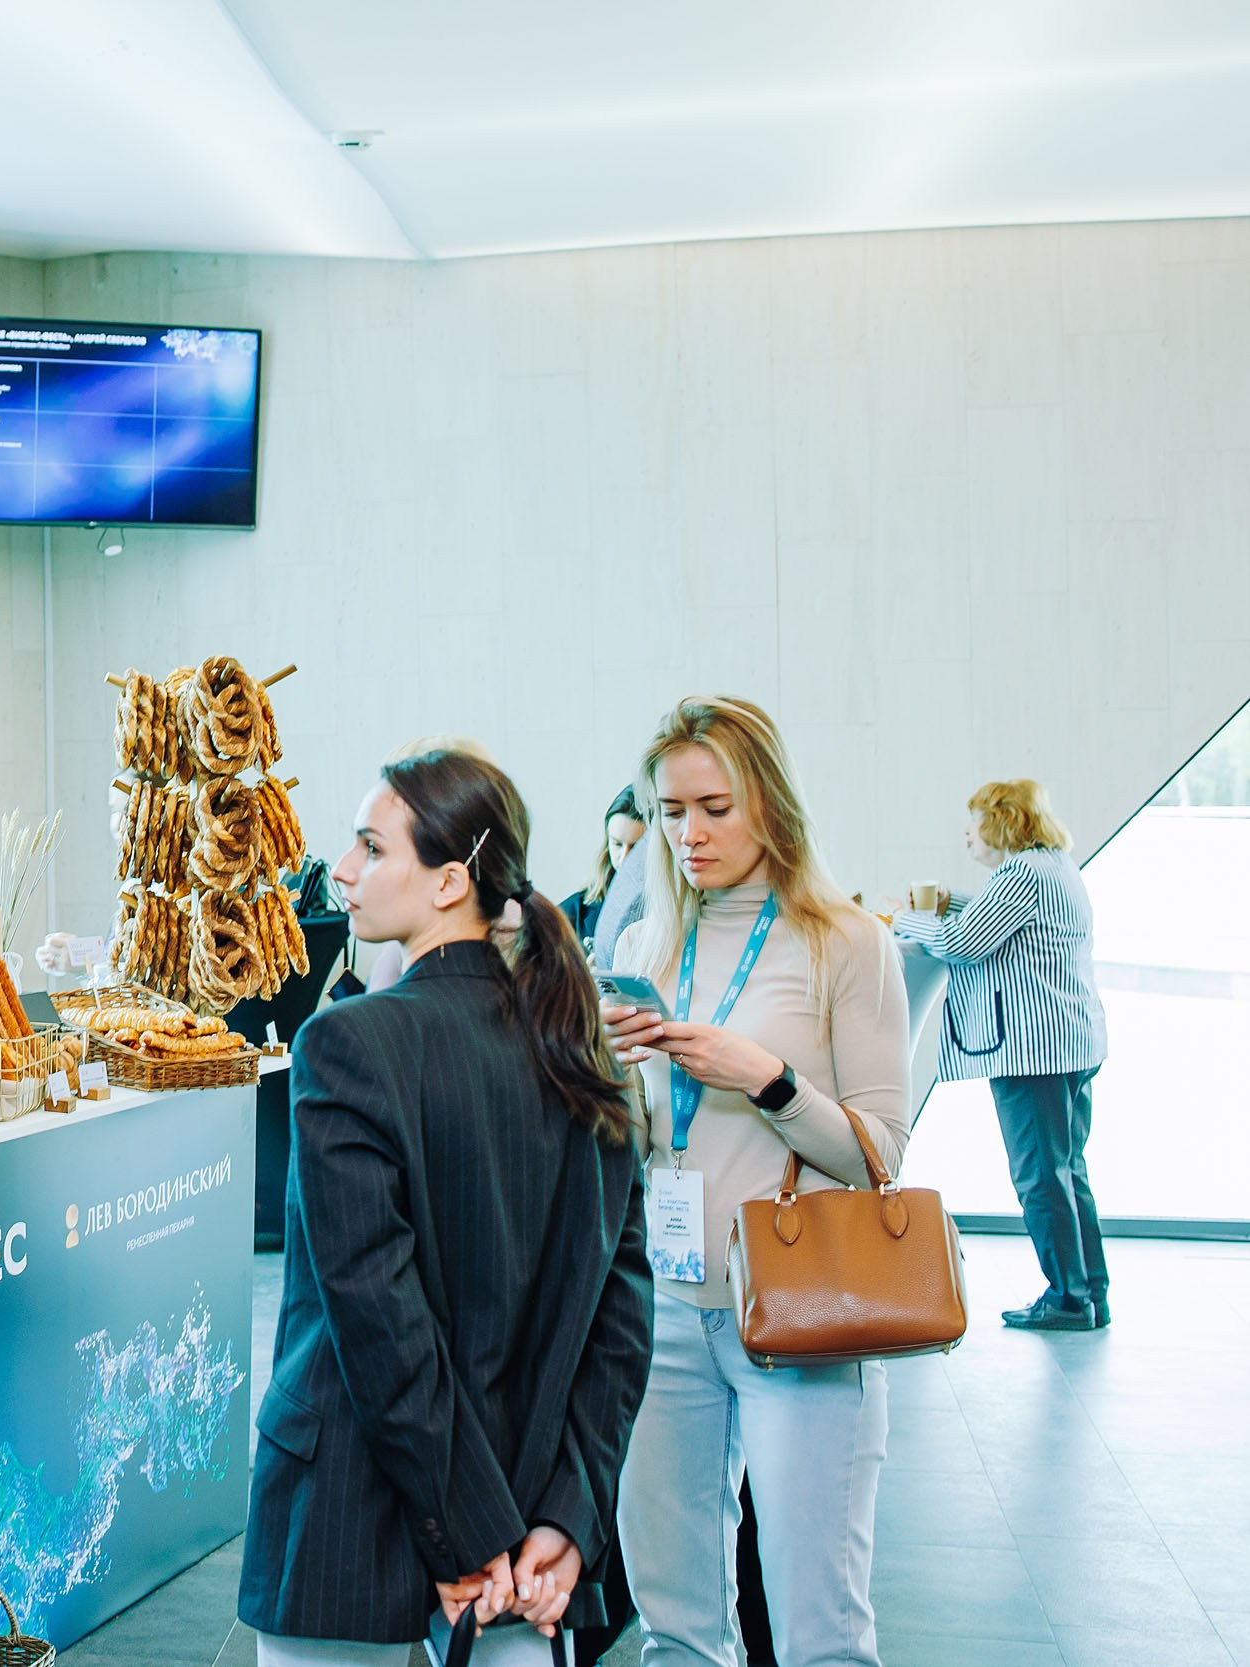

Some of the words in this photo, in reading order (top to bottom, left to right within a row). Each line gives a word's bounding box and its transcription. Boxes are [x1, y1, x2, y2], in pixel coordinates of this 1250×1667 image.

[84, 1201, 112, 1237] ЛЕВ
[117, 1152, 231, 1225] БОРОДИНСКИЙ
[126, 1225, 169, 1252] РЕМЕСЛЕННАЯ
[169, 1215, 195, 1234] ПЕКАРНЯ
